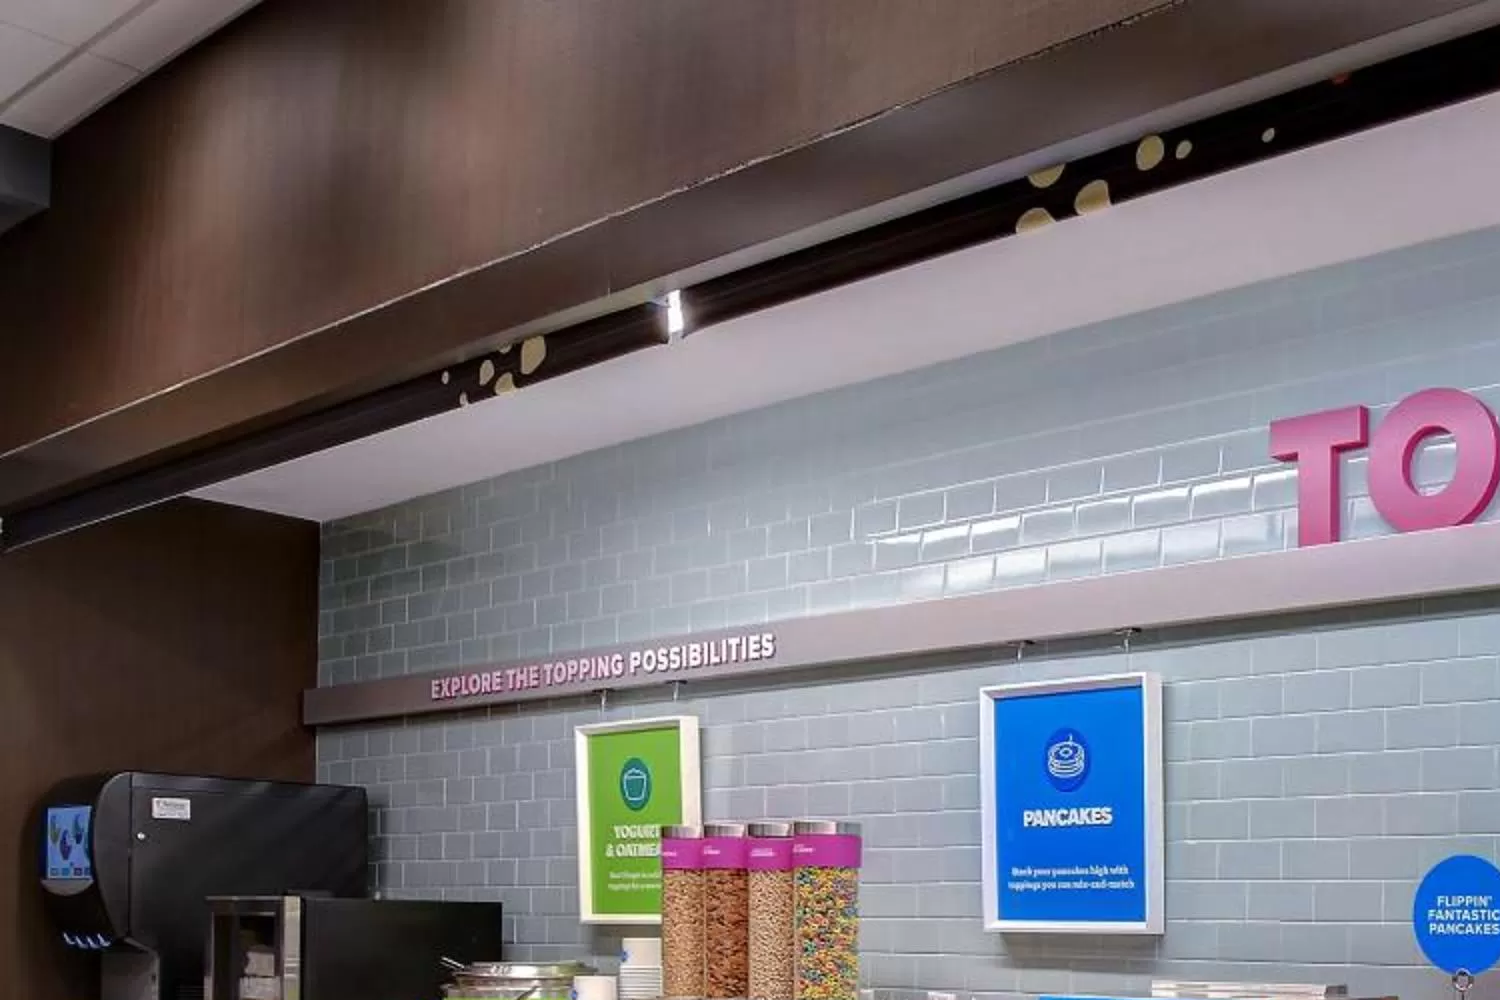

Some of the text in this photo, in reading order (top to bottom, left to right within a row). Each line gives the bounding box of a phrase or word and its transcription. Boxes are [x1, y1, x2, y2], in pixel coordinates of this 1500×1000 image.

[431, 632, 776, 700] EXPLORE THE TOPPING POSSIBILITIES
[1023, 806, 1113, 828] PANCAKES
[605, 843, 615, 857] &
[615, 843, 662, 857] OATME
[1089, 865, 1109, 878] high
[1110, 864, 1130, 876] with
[1042, 882, 1057, 892] you
[1437, 895, 1493, 907] FLIPPIN'
[1427, 909, 1500, 921] FANTASTIC
[1429, 923, 1500, 936] PANCAKES
